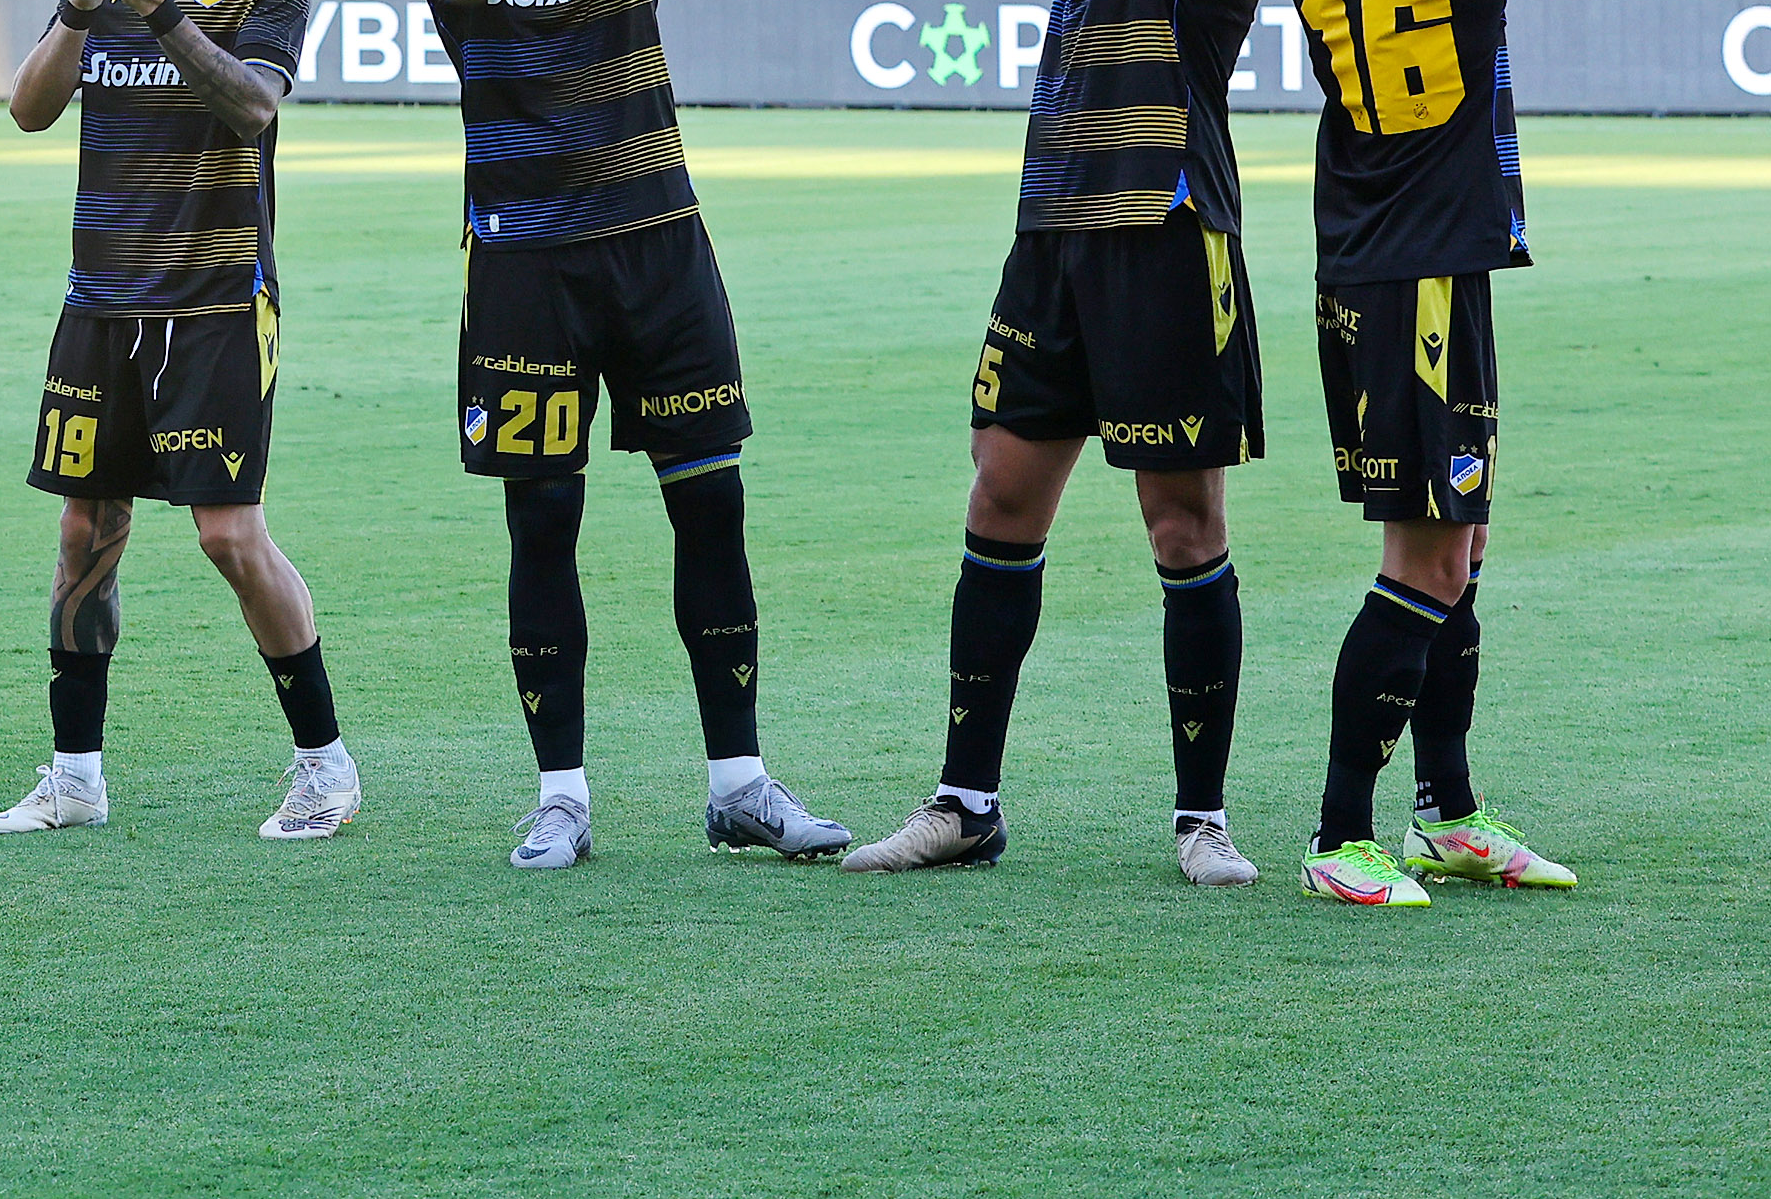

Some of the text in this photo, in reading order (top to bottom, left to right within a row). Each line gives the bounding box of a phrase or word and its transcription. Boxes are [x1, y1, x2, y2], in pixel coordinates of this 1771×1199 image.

[483, 354, 577, 377] cablenet
[974, 343, 1004, 413] 5
[640, 380, 741, 417] NUROFEN
[495, 389, 580, 456] 20
[41, 407, 99, 479] 19
[701, 623, 753, 636] APOEL
[539, 646, 558, 657] FC
